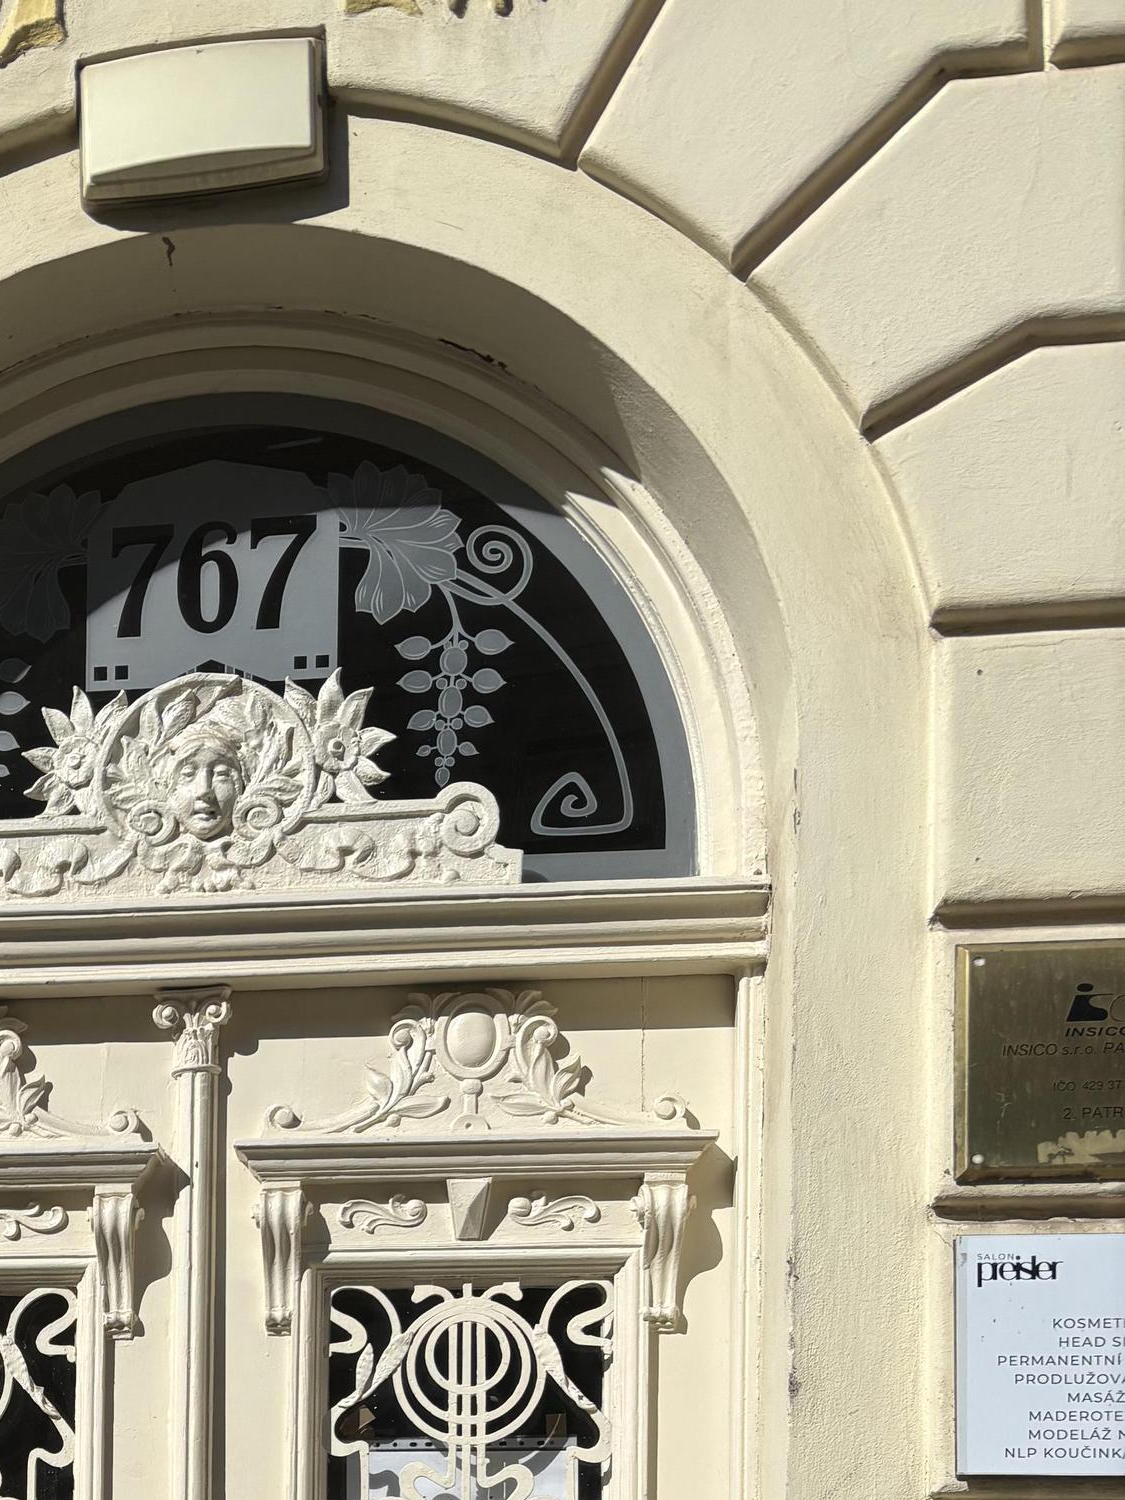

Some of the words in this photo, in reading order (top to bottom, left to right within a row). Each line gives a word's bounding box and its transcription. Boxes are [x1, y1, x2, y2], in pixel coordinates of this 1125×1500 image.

[111, 513, 318, 639] 767
[1002, 1043, 1057, 1057] INSICO
[1061, 1045, 1096, 1055] s.r.o.
[1062, 1107, 1075, 1120] 2.
[1059, 1336, 1106, 1348] HEAD
[998, 1354, 1121, 1366] PERMANENTNÍ
[1067, 1389, 1125, 1403] MASÁŽ
[1029, 1410, 1124, 1422] MADEROTE
[1029, 1427, 1112, 1440] MODELÁŽ
[1005, 1448, 1036, 1458] NLP
[1043, 1445, 1125, 1459] KOUČINK
